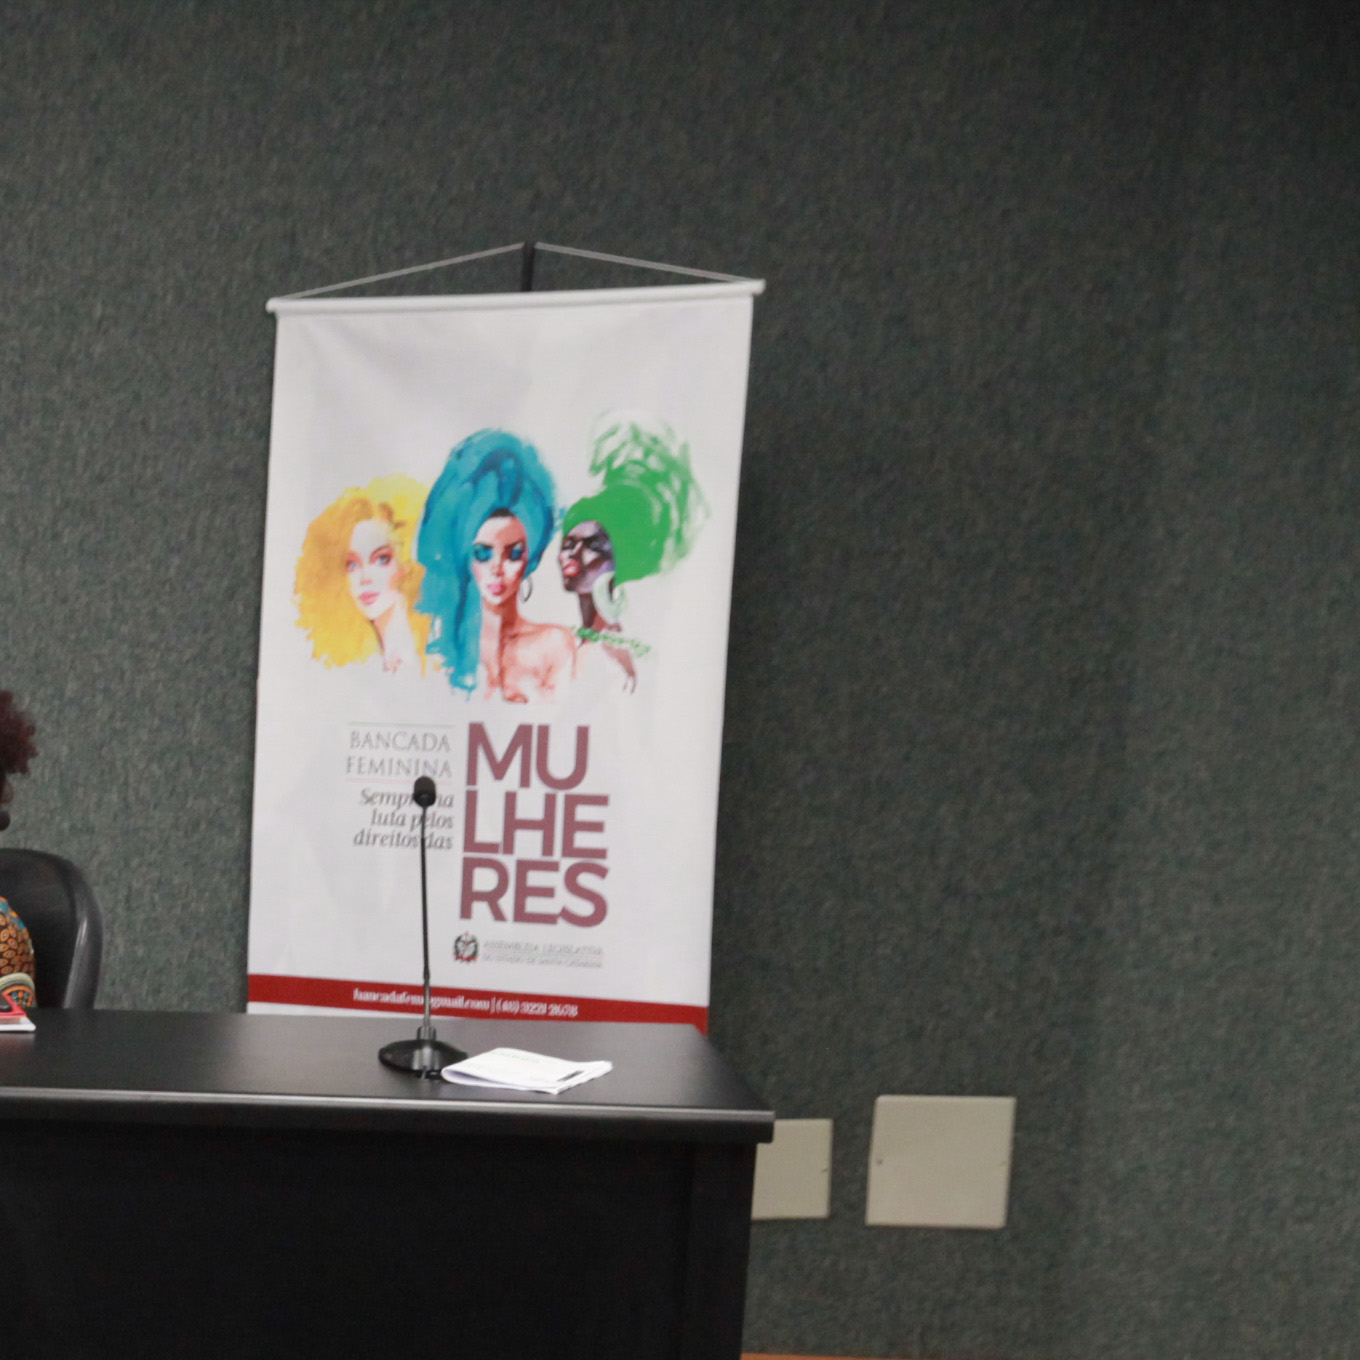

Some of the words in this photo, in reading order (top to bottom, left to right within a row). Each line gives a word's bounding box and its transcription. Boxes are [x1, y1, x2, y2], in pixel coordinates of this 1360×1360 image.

[350, 731, 451, 752] BANCADA
[346, 755, 452, 778] FEMININA
[467, 722, 590, 790] MU
[360, 787, 416, 810] Sempr
[370, 808, 406, 826] luta
[410, 811, 454, 831] pelos
[464, 790, 610, 859] LHE
[353, 828, 418, 848] direitos
[460, 857, 610, 928] RES
[353, 988, 490, 1010] bancadafemgmail.com
